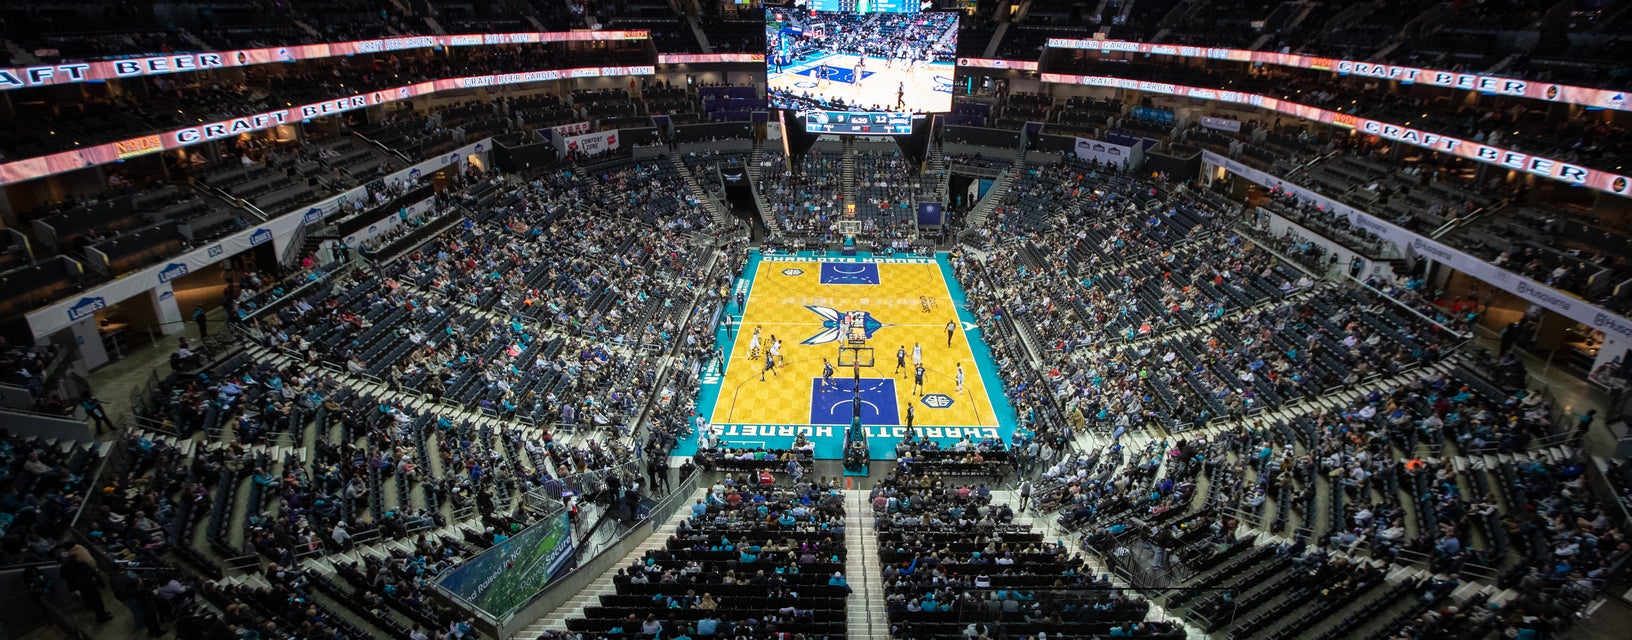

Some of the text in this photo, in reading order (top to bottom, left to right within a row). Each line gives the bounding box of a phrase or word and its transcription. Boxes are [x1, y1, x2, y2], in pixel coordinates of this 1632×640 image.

[114, 53, 222, 77] BEER
[1338, 60, 1422, 82] CRAFT
[1434, 71, 1528, 96] BEER
[175, 109, 289, 144] CRAFT
[301, 95, 367, 119] BEER
[875, 115, 887, 123] 12
[1364, 119, 1462, 151] CRAFT
[1476, 145, 1588, 184] BEER
[845, 426, 999, 438] CHARLOTT
